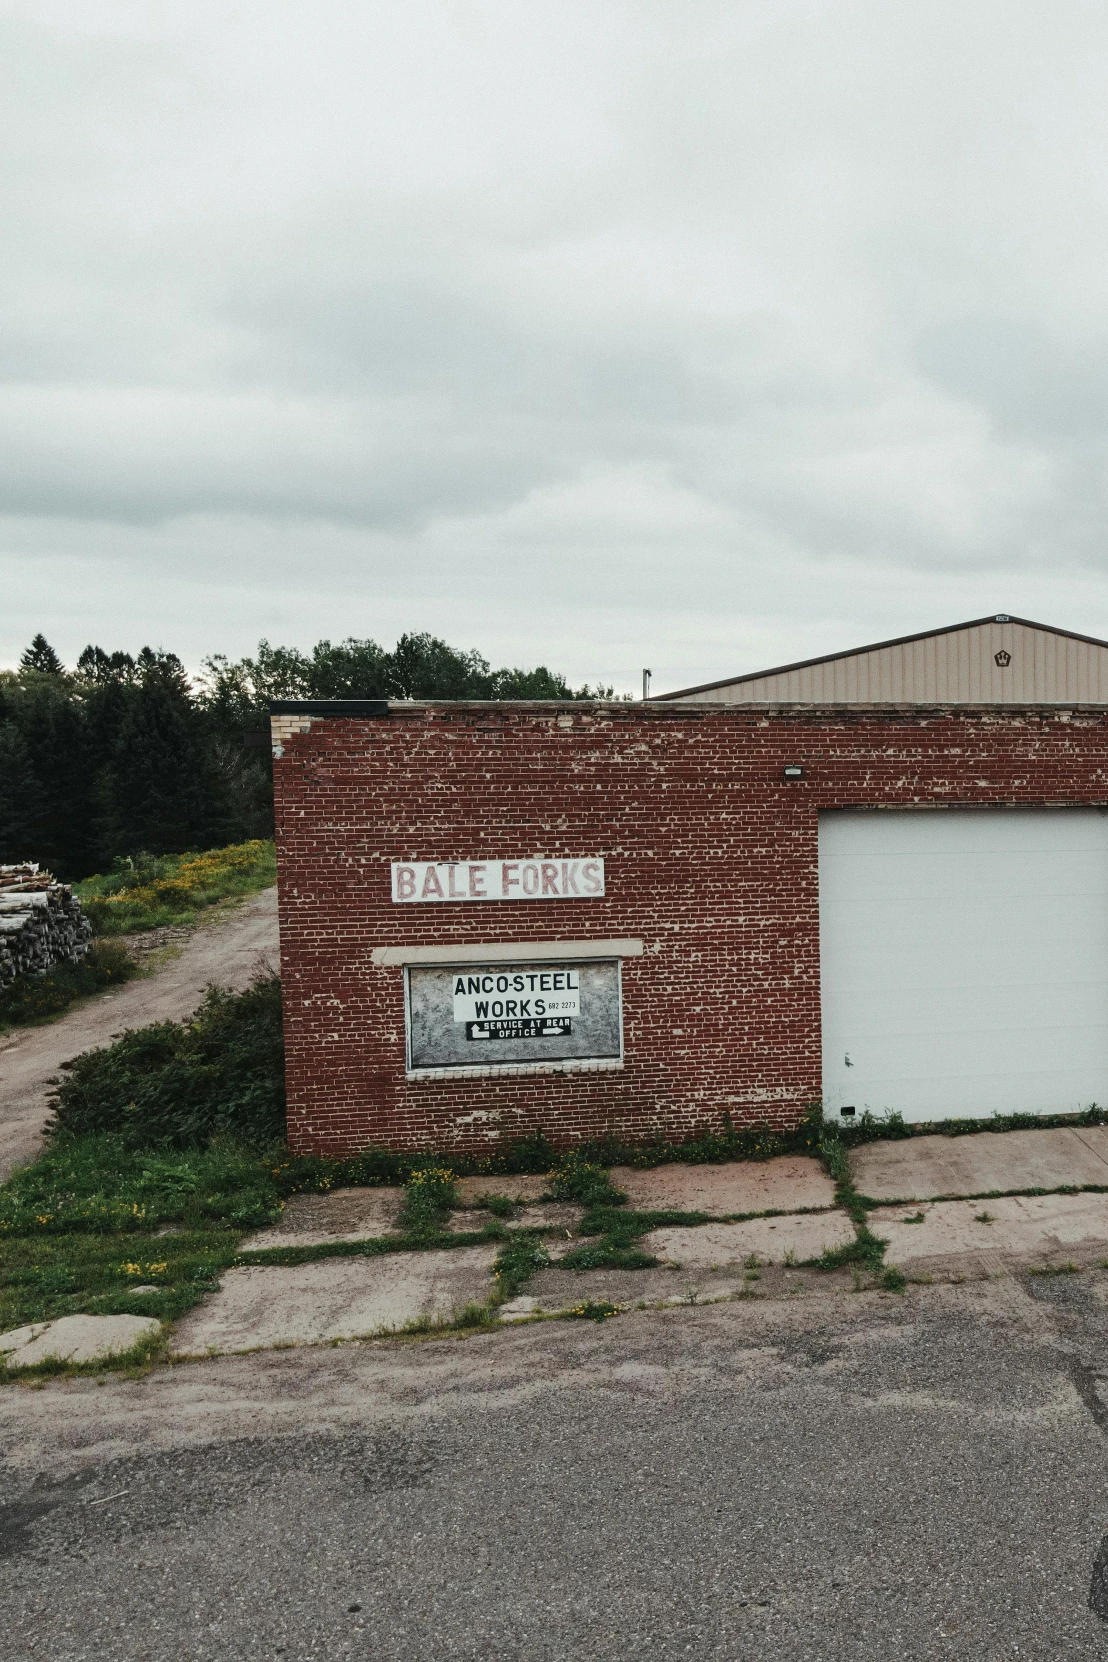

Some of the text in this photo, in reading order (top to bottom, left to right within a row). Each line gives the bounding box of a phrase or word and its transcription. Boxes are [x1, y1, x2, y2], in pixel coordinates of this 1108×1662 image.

[396, 862, 600, 899] BALE FORKS
[454, 972, 579, 996] ANCO-STEEL
[475, 998, 546, 1019] WORKS
[561, 1001, 576, 1009] 2273
[484, 1018, 570, 1030] SERVICE AT REAR
[498, 1028, 536, 1038] OFFICE
